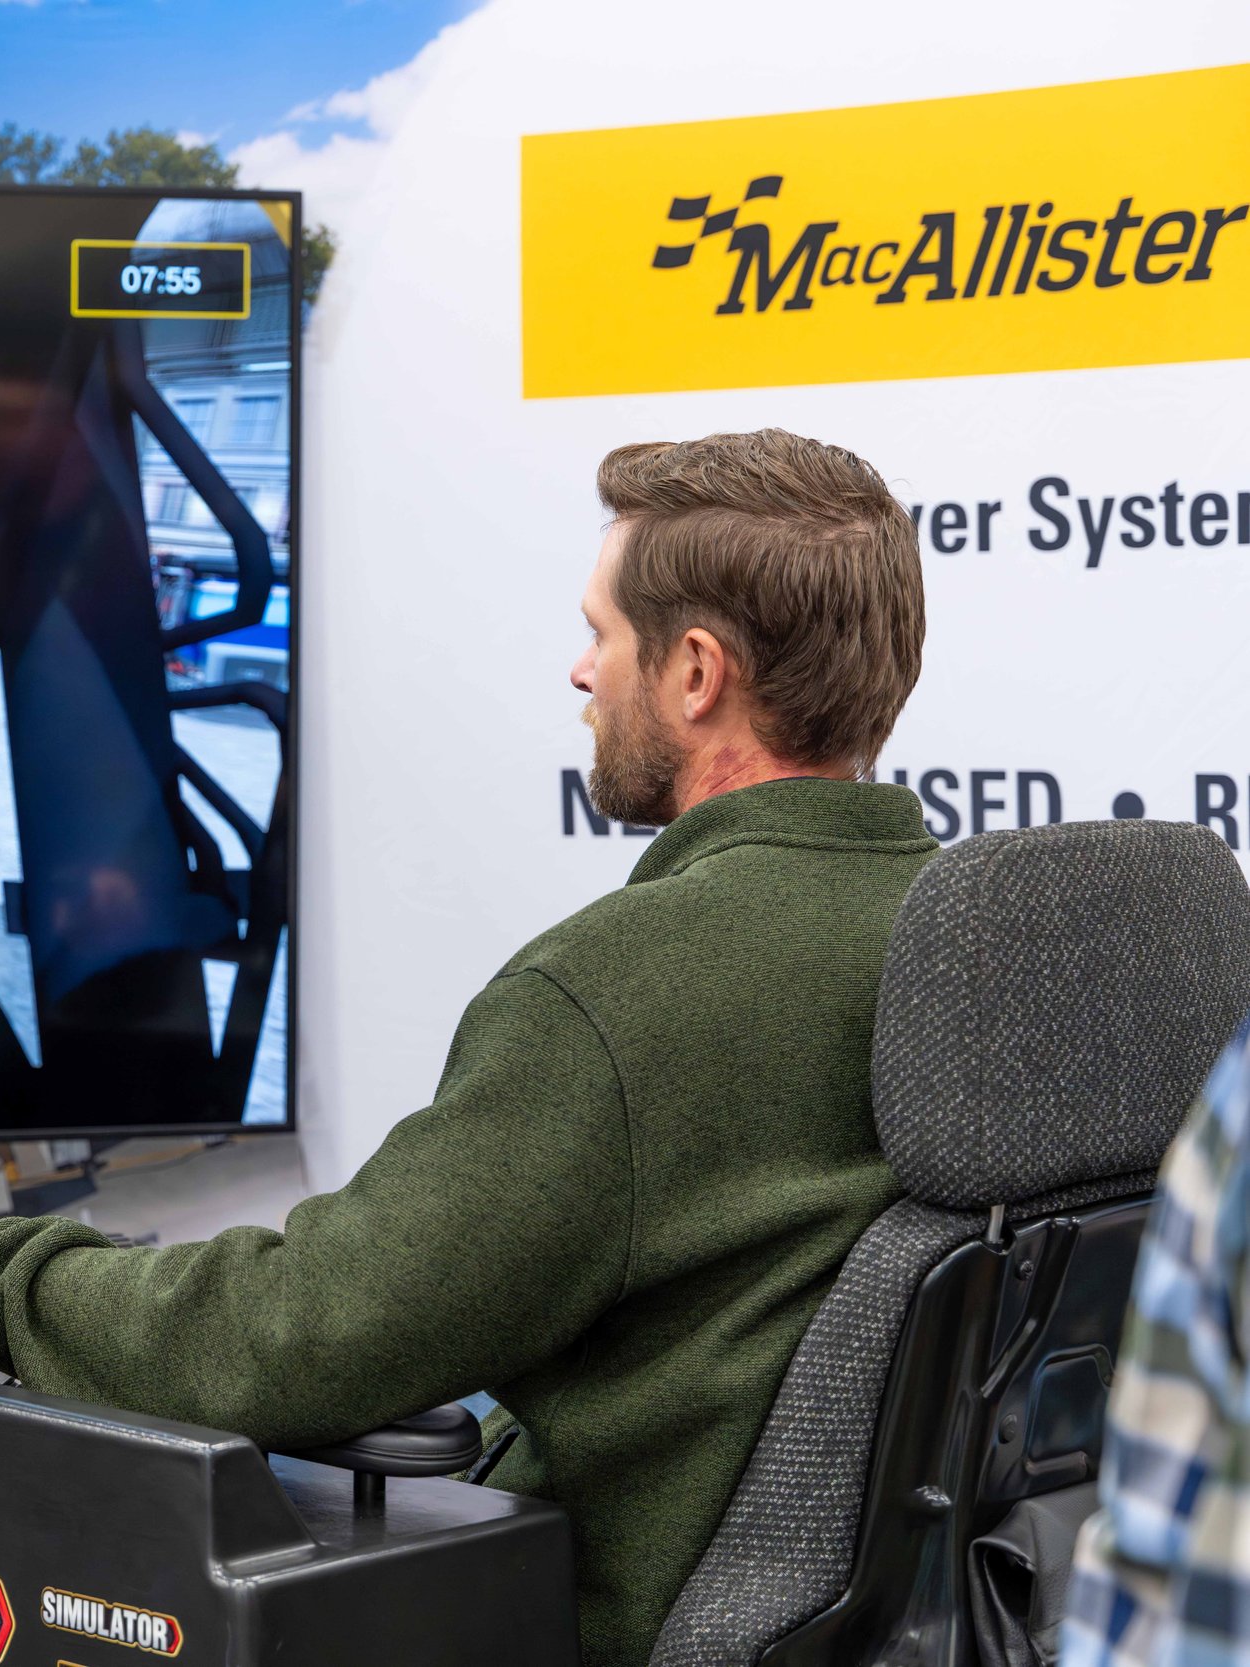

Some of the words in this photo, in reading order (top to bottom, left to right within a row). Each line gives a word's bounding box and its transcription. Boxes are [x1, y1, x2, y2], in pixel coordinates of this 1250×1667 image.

[120, 265, 202, 295] 07:55
[714, 195, 1250, 316] MacAllister
[1027, 476, 1250, 569] Syste
[42, 1589, 170, 1651] SIMULATOR
